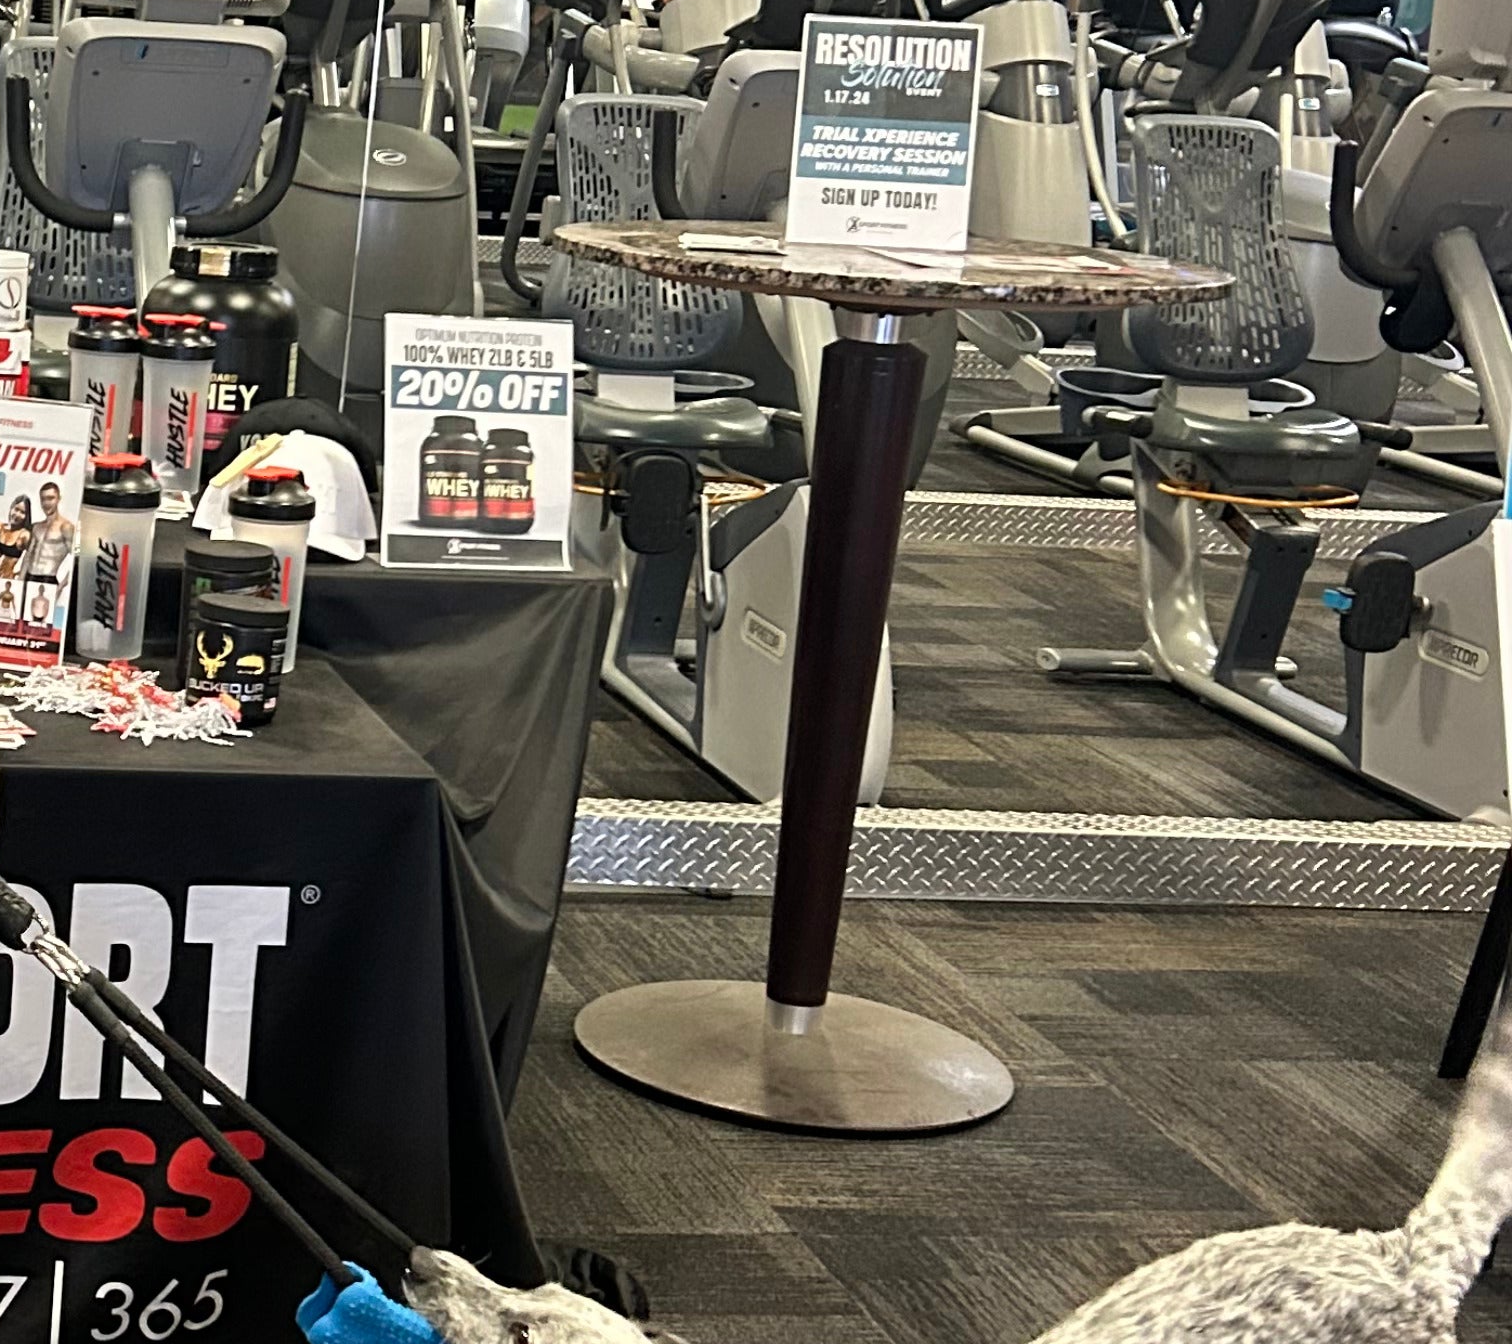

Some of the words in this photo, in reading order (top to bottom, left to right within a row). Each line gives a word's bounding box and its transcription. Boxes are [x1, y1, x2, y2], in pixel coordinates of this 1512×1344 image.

[815, 33, 972, 71] RESOLUTION
[824, 89, 871, 105] 1.17.24
[812, 125, 860, 142] TRIAL
[862, 127, 960, 147] XPERIENCE
[800, 143, 892, 162] RECOVERY
[892, 147, 967, 166] SESSION
[821, 187, 856, 206] SIGN
[861, 189, 879, 207] UP
[885, 190, 937, 210] TODAY!
[415, 328, 456, 342] OPTIMUM
[505, 332, 543, 346] PROTEIN
[404, 344, 444, 364] 100%
[447, 346, 486, 365] WHEY
[489, 349, 513, 367] 2LB
[517, 350, 527, 368] &
[529, 350, 554, 369] 5LB
[208, 383, 259, 412] HEY
[396, 369, 494, 410] 20%
[498, 373, 564, 412] OFF
[165, 387, 190, 469] HUSTLE
[426, 478, 479, 497] WHEY
[92, 537, 120, 632] HUSTLE
[90, 1268, 228, 1344] 365
